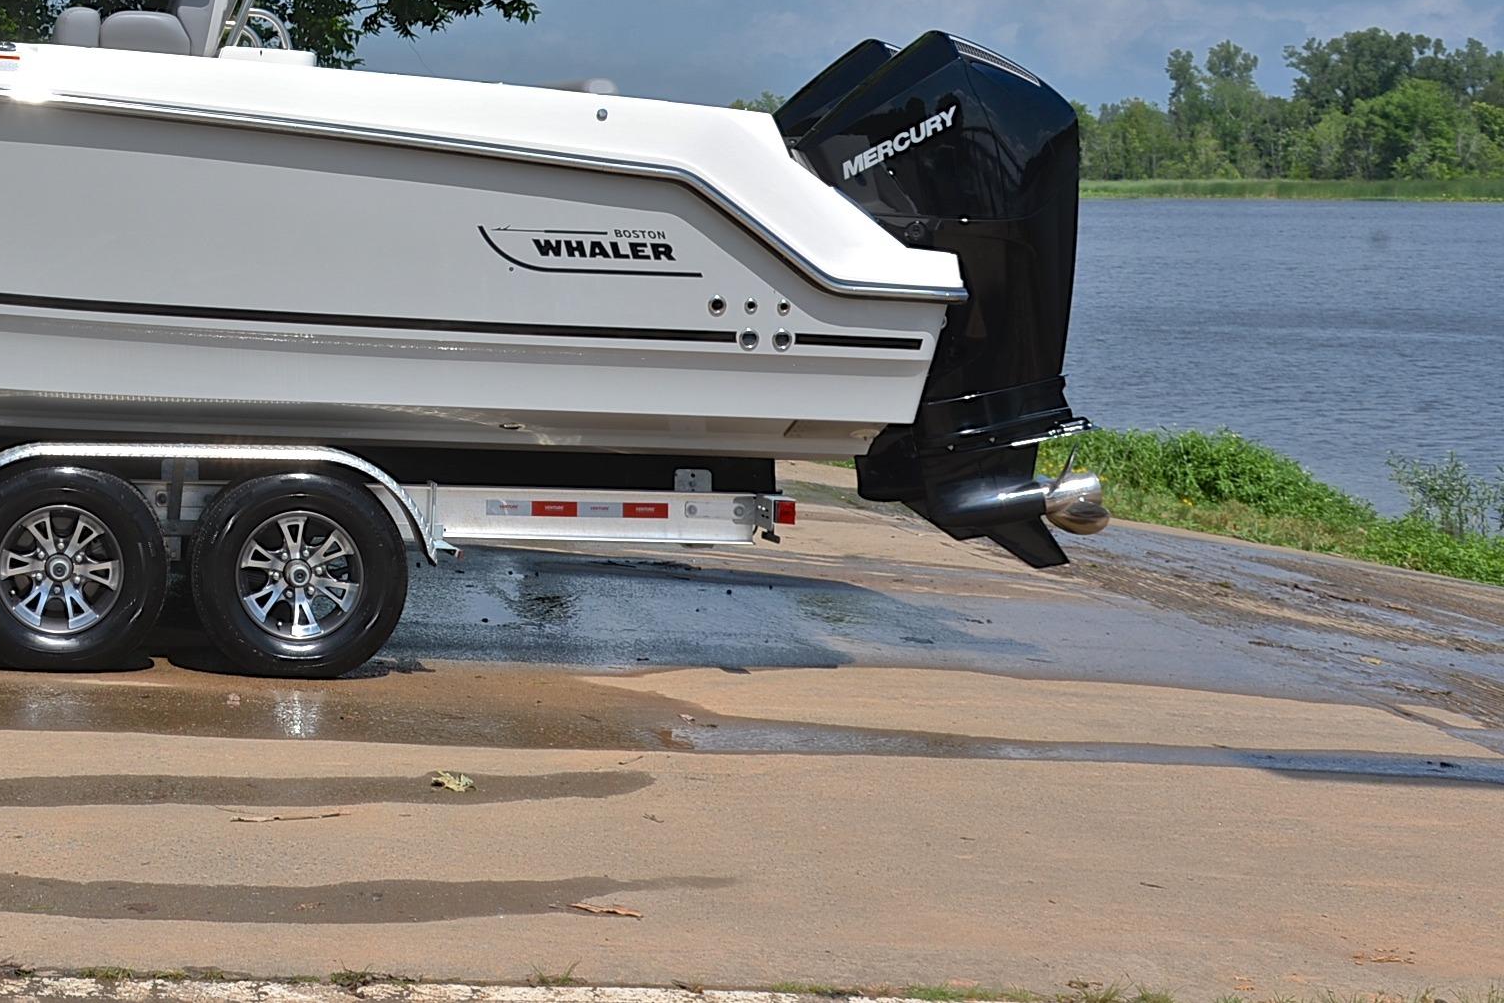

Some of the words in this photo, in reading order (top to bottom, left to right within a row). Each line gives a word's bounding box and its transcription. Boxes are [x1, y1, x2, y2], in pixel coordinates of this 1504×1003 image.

[842, 105, 956, 180] MERCURY
[614, 229, 666, 240] BOSTON
[532, 238, 677, 261] WHALER
